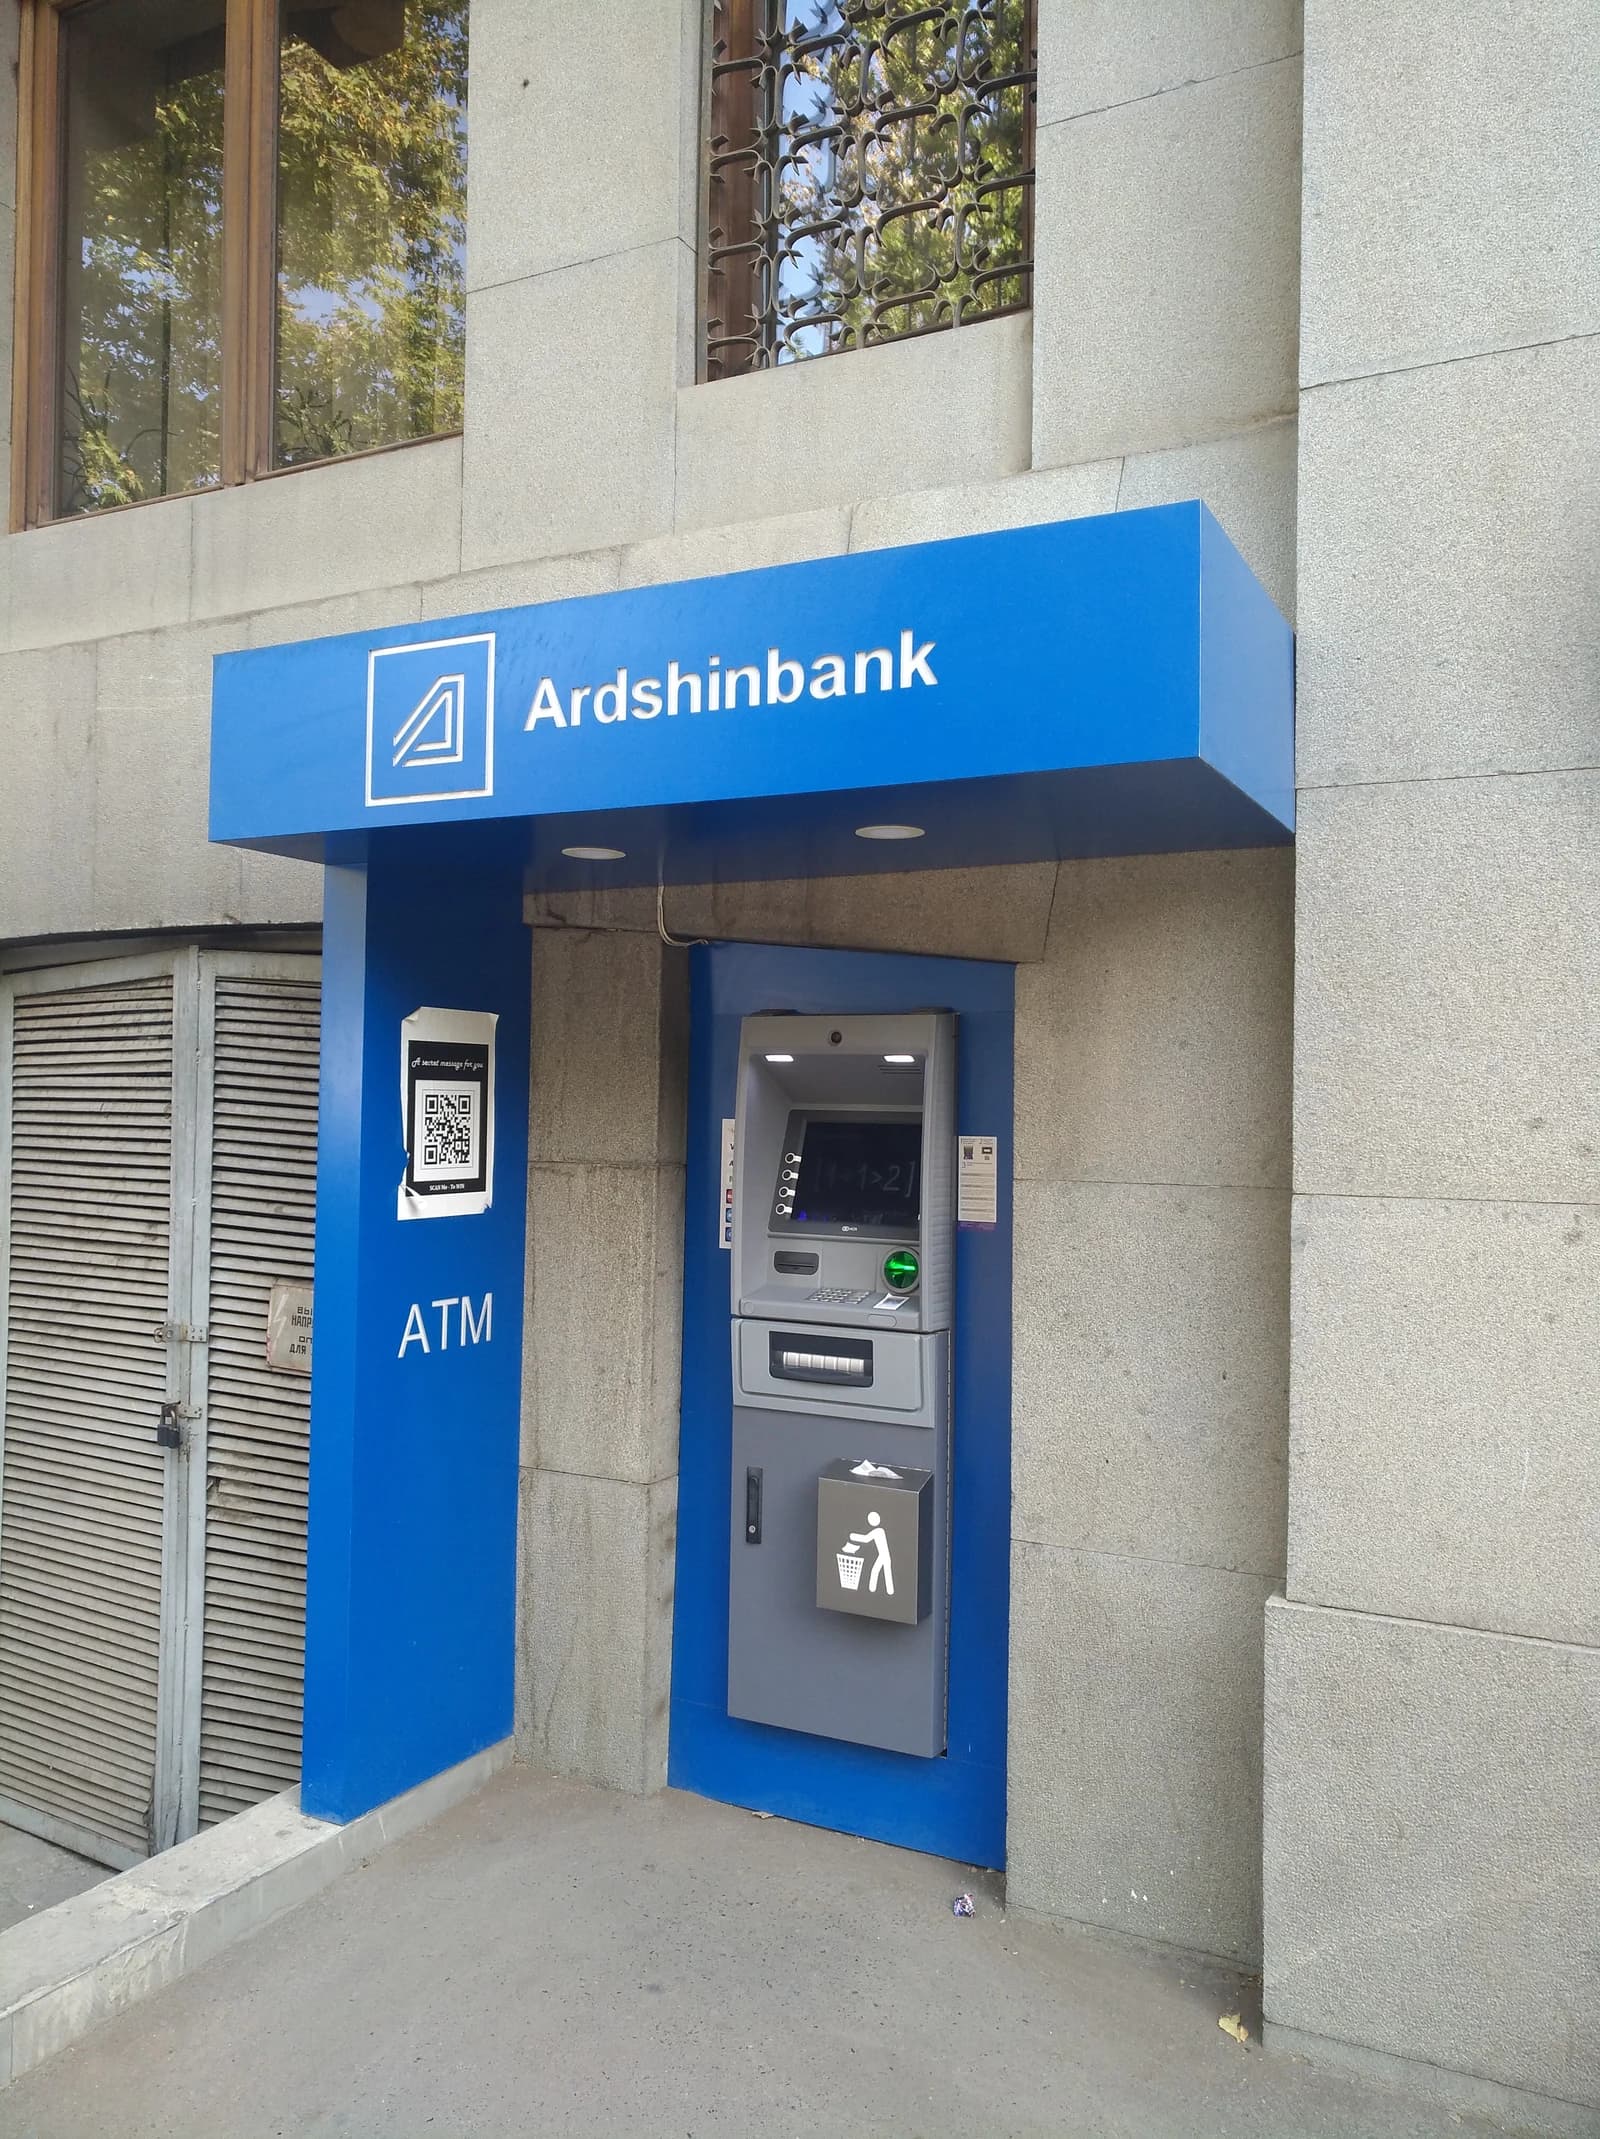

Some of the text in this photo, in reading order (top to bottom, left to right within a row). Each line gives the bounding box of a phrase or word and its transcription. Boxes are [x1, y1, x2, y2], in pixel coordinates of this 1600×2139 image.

[524, 630, 937, 731] Ardshinbank
[411, 1057, 421, 1067] A
[440, 1061, 463, 1071] message
[463, 1059, 473, 1071] for
[473, 1062, 484, 1071] you
[291, 1315, 313, 1328] НАПР
[398, 1292, 493, 1358] ATM
[289, 1344, 306, 1354] ДЛЯ
